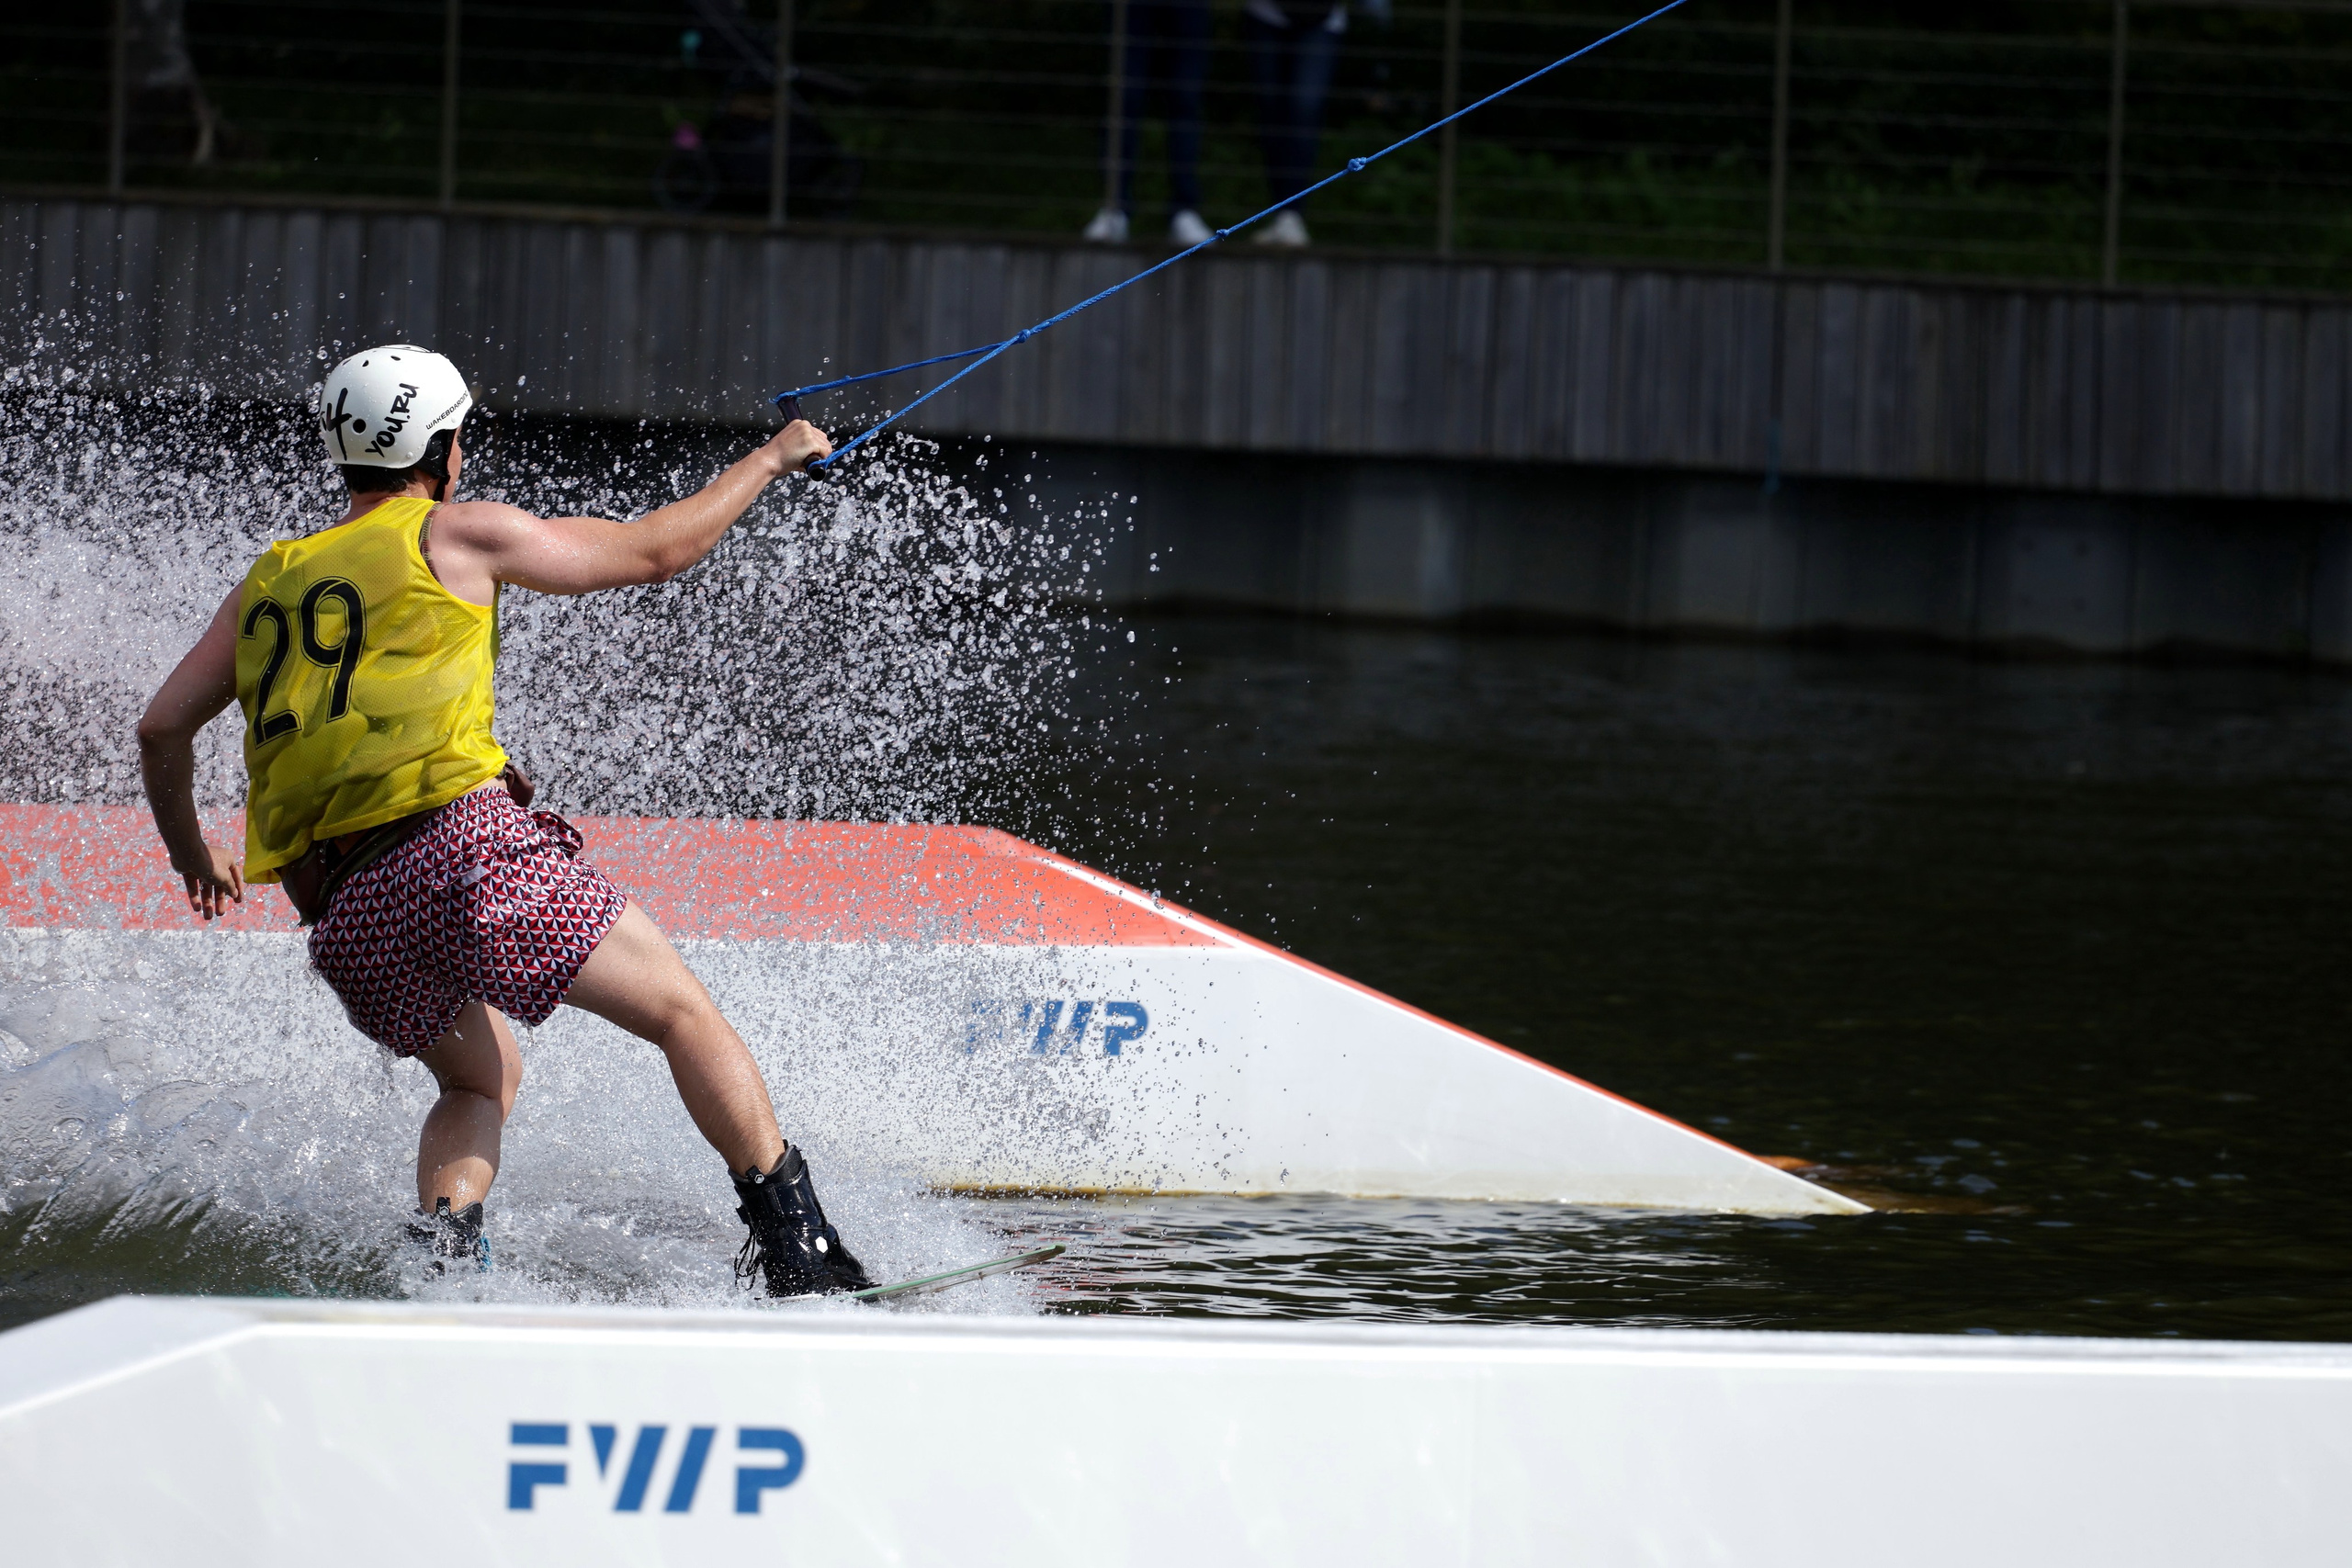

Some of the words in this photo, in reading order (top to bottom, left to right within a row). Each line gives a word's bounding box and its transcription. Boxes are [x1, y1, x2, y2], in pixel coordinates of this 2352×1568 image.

[425, 389, 469, 430] WAKEBOARDIN
[242, 575, 367, 750] 29
[507, 1423, 806, 1515] FWP
